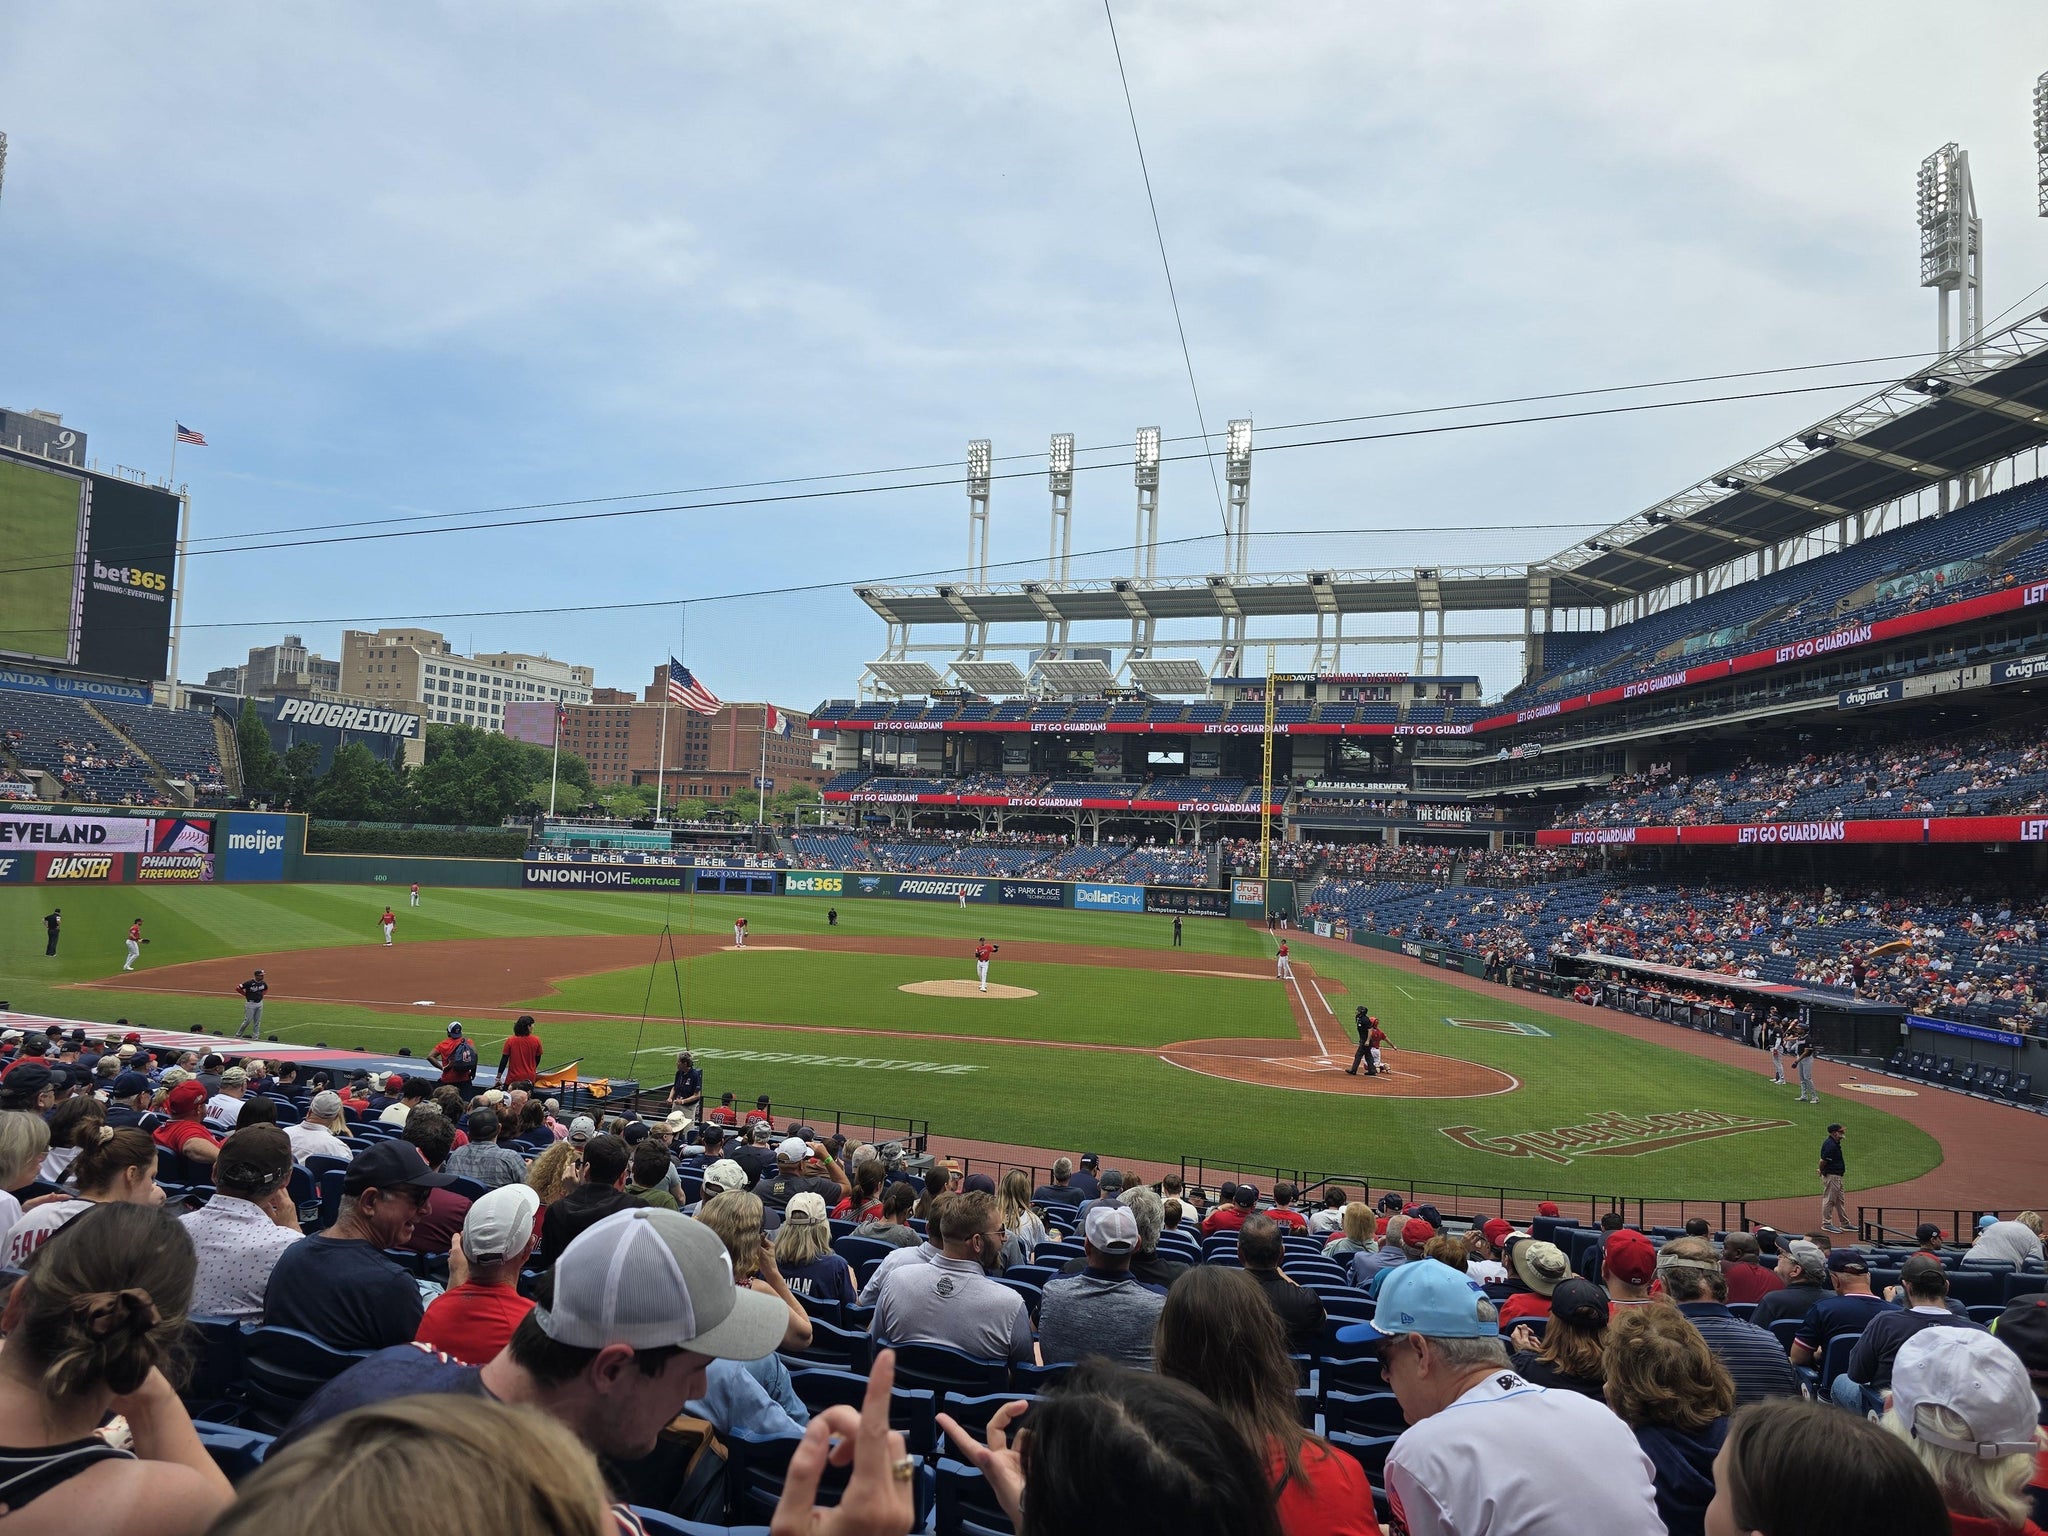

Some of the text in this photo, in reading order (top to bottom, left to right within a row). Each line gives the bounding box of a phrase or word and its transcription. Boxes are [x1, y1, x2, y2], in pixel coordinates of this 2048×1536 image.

[56, 430, 77, 450] 9
[93, 559, 166, 591] bet365
[93, 581, 123, 594] WINNING
[127, 588, 165, 602] EVERYTHING
[1776, 624, 1872, 663] LET'S GO GUARDIANS
[1321, 672, 1410, 683] PENNANT DISTRICT
[2005, 662, 2033, 678] drug
[0, 671, 50, 687] NDA
[1624, 670, 1687, 698] LET'S GO GUARDIANS
[73, 680, 144, 699] HONDA
[1846, 687, 1889, 705] drug mart
[277, 698, 419, 737] PROGRESSIVE
[1526, 709, 1535, 720] GO
[1535, 701, 1561, 719] GUARDIANS
[873, 721, 943, 730] LET'S GO GUARDIANS
[1031, 723, 1107, 731] LET'S GO GUARDIANS
[1204, 725, 1222, 733] LET'S
[1223, 725, 1239, 733] GO
[1394, 723, 1474, 734] LET'S GO GUARDIANS
[1317, 781, 1333, 789] FAT
[1334, 782, 1365, 790] HEAD'S
[877, 793, 919, 802] GUARDIANS
[1008, 798, 1083, 807] LET'S GO GUARDIANS
[10, 803, 55, 812] PROGRESSIVE
[128, 808, 169, 816] PROGRESSIVE
[1178, 803, 1261, 814] LET'S GO GUARDIANS
[1416, 809, 1472, 822] THE CORNER
[1571, 828, 1636, 844] LET'S GO GUARDIANS
[1738, 822, 1845, 843] LET'S GO GUARDIANS
[228, 829, 284, 854] meijer
[46, 857, 112, 879] BLASTER
[141, 856, 202, 868] PHANTOM
[139, 868, 200, 879] FIREWORKS
[631, 876, 681, 887] MORTGAGE
[786, 874, 842, 892] bet365
[899, 880, 985, 897] PROGRESSIVE
[1236, 884, 1258, 895] drug
[1018, 887, 1060, 896] PARK PLACE
[629, 1046, 990, 1075] PROGRESSIVE
[1438, 1109, 1756, 1165] Guardians
